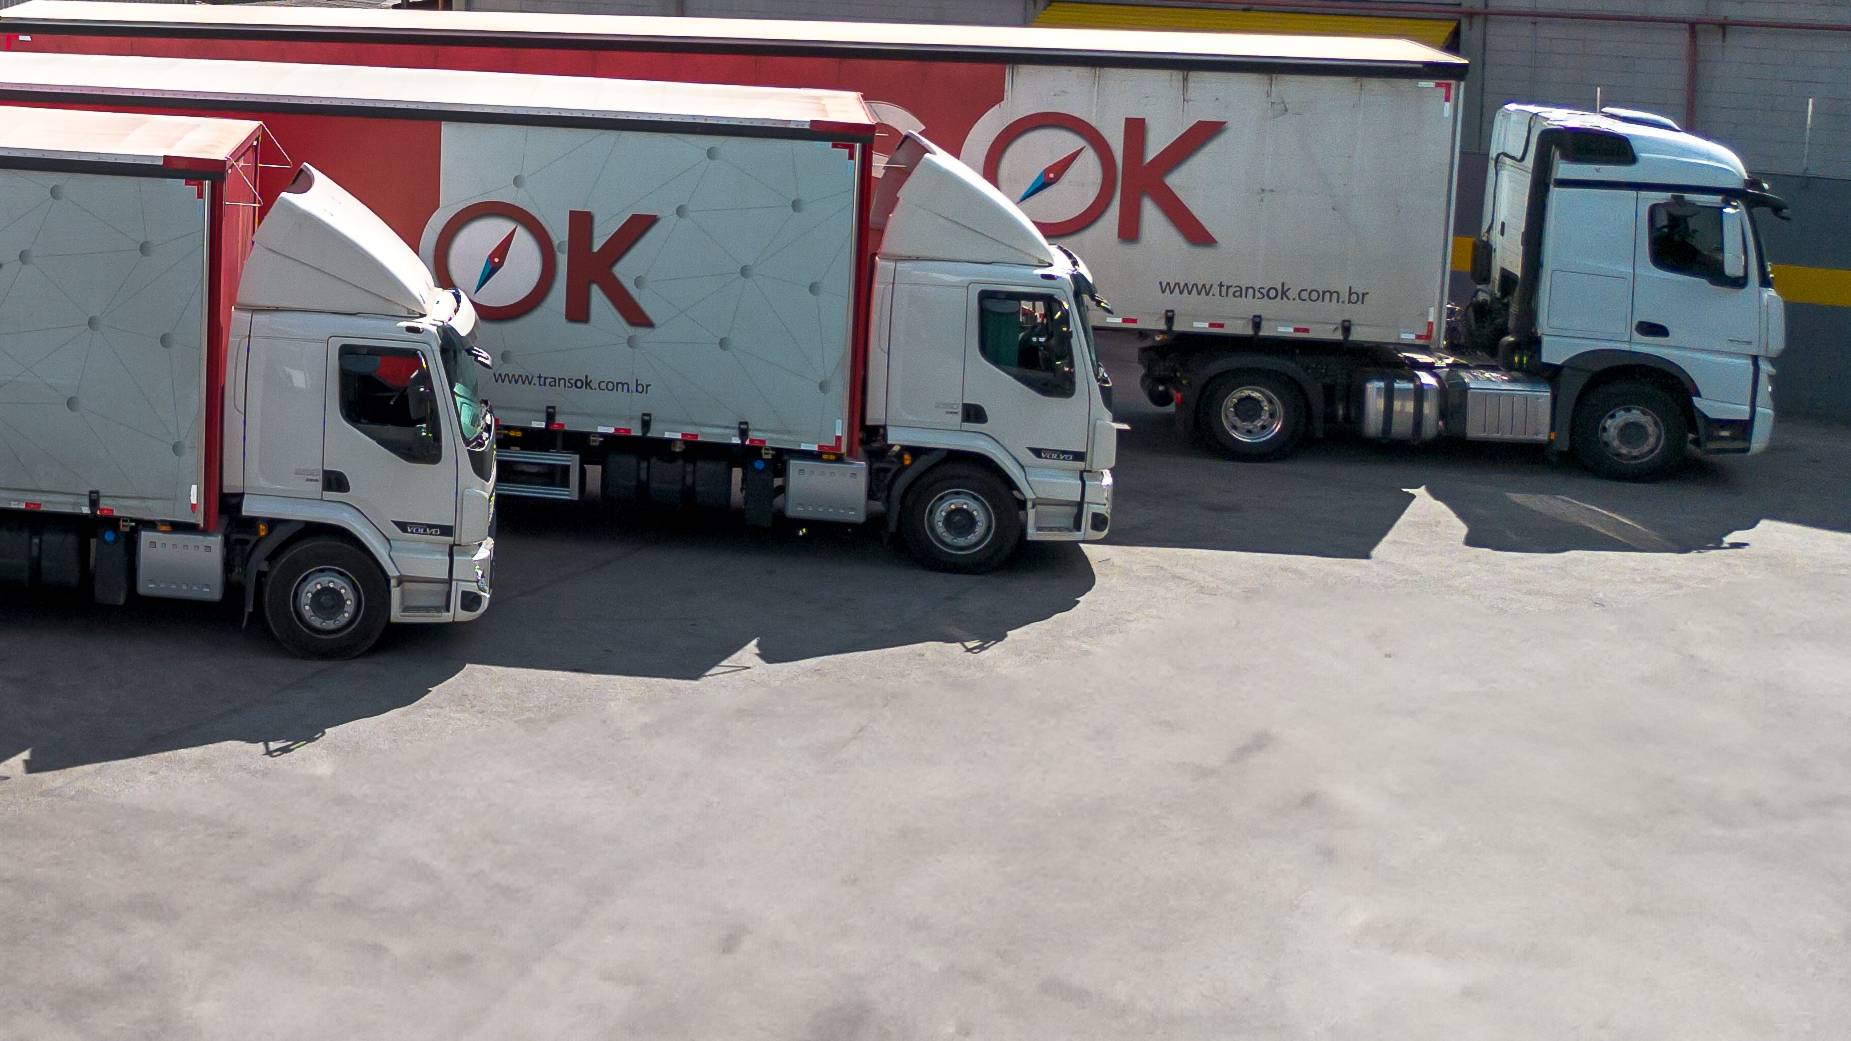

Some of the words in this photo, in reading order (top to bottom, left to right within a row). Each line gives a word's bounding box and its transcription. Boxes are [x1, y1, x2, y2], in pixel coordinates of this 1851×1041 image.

[1158, 280, 1369, 304] www.transok.com.br
[493, 372, 651, 394] www.transok.com.br
[407, 525, 440, 535] VOLVO
